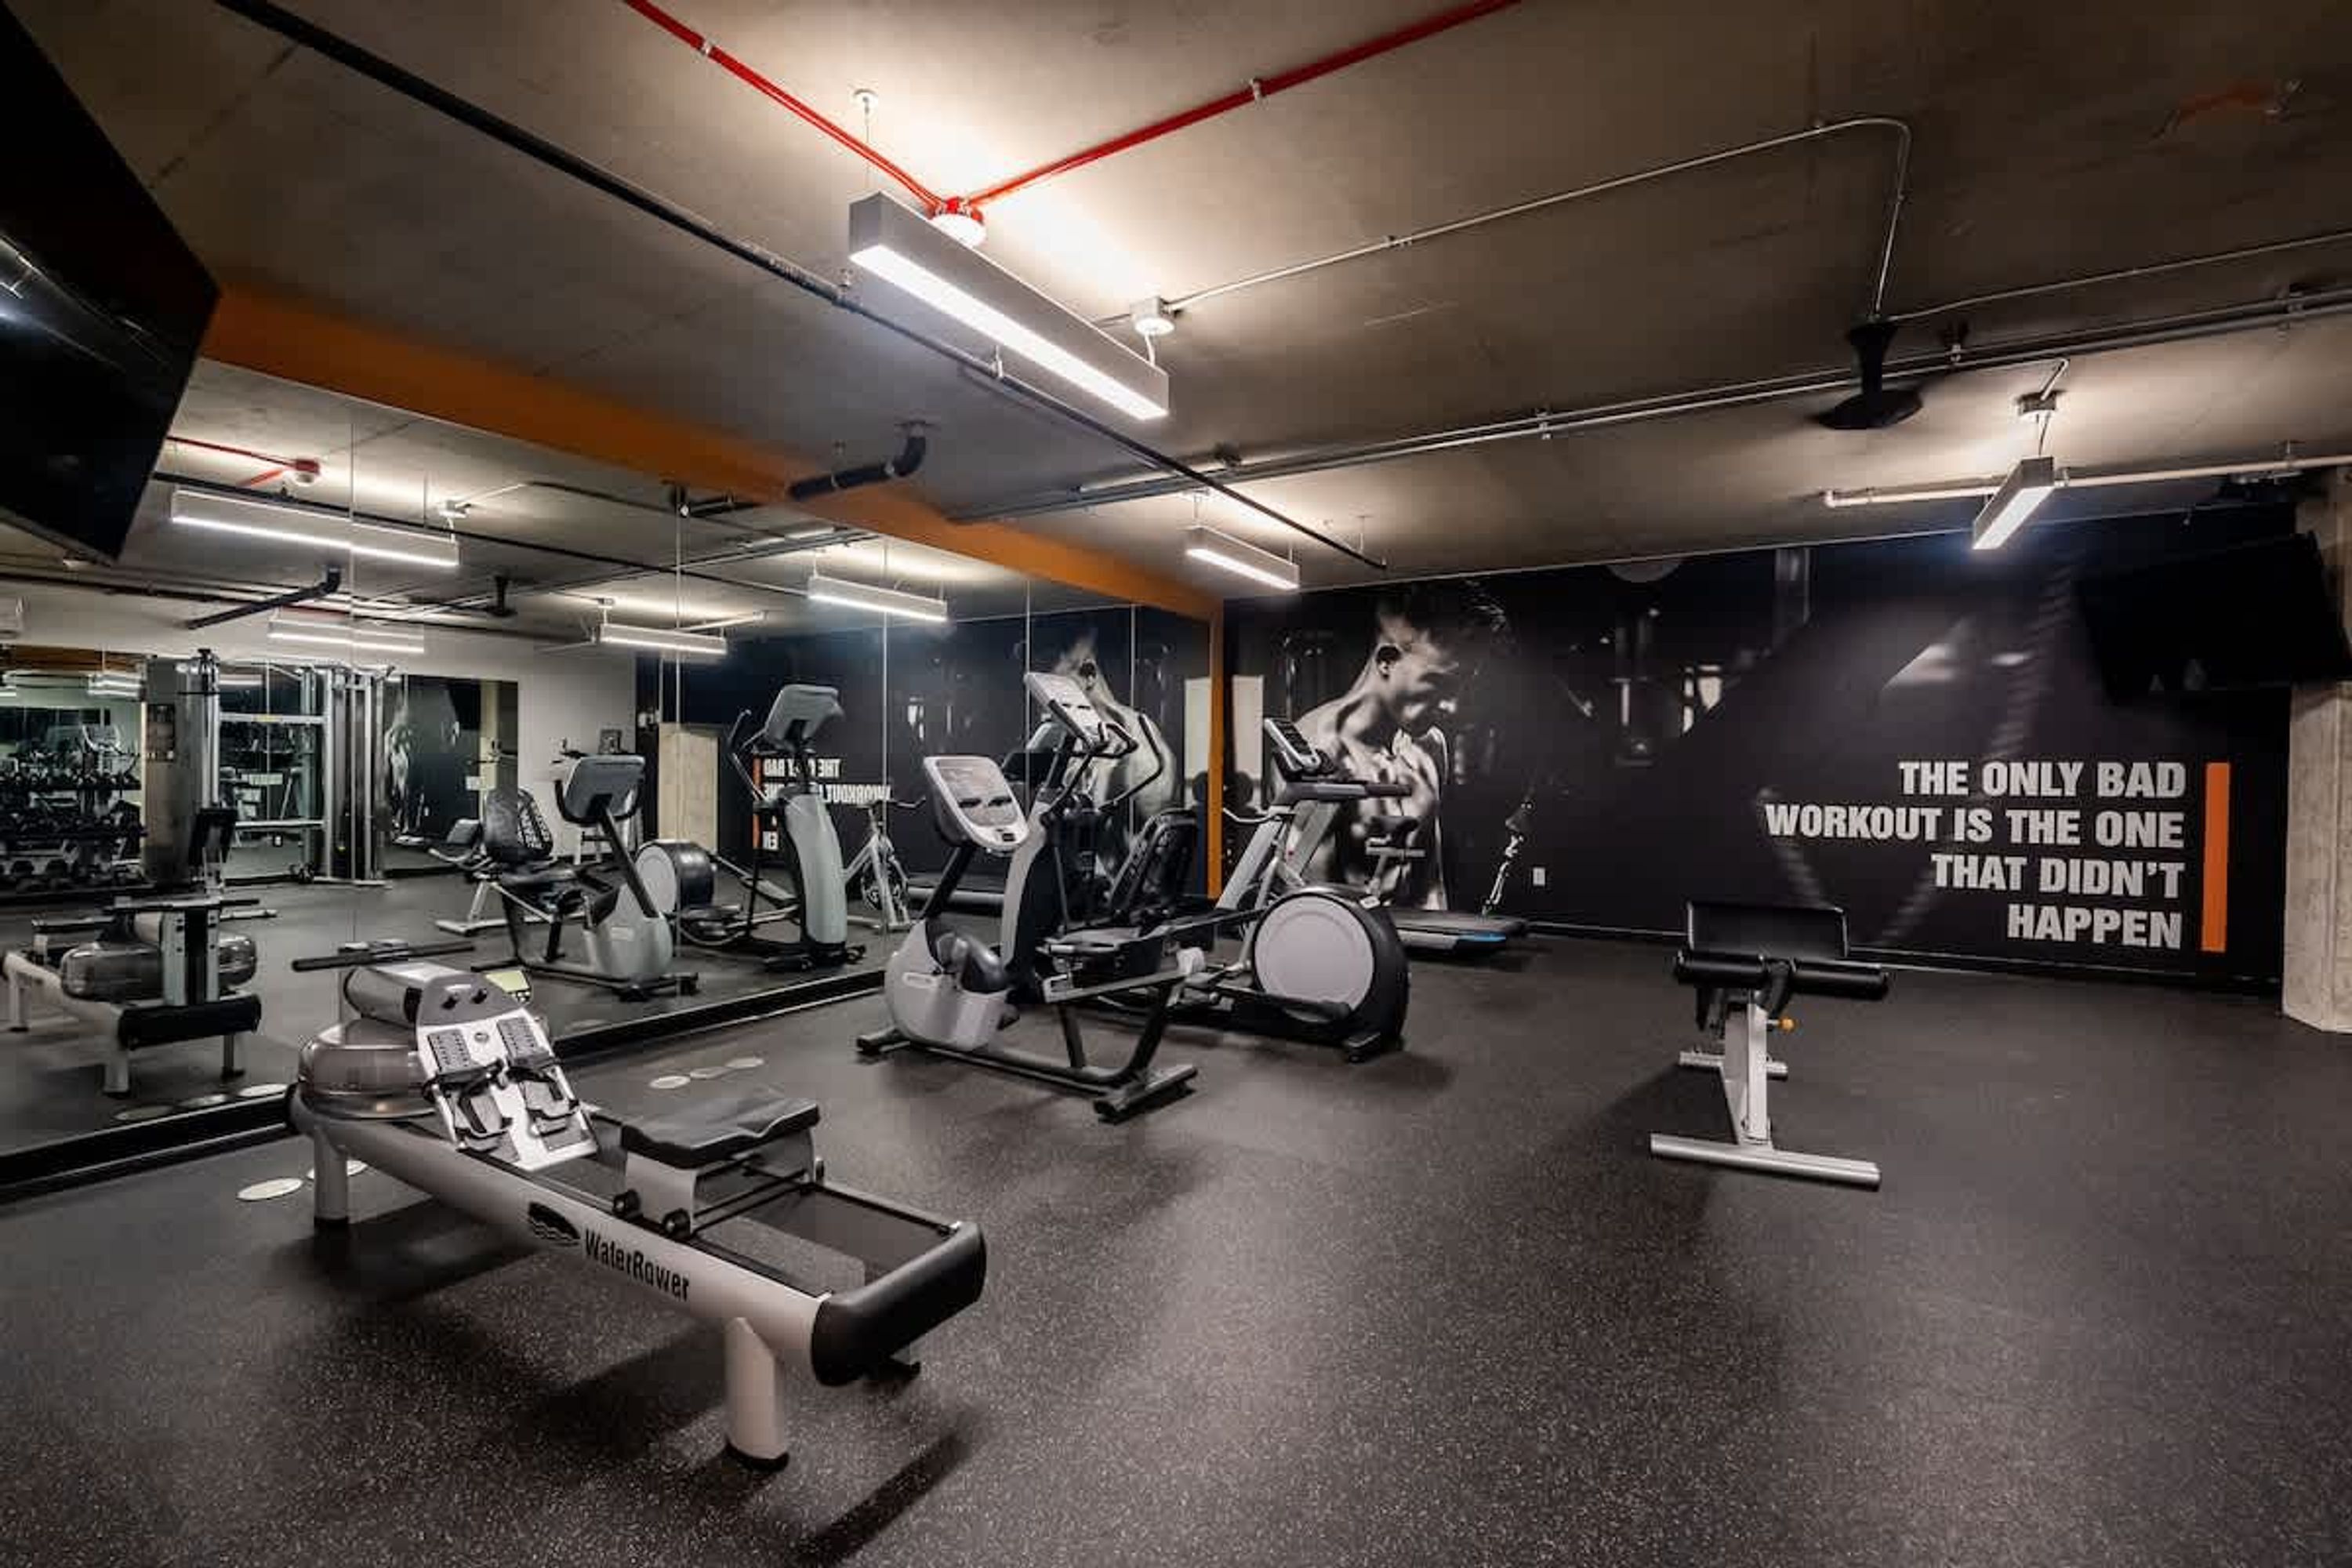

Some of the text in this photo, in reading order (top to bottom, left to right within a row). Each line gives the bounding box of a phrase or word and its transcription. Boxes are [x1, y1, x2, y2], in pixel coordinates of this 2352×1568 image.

[1899, 761, 2186, 798] THE ONLY BAD
[1764, 804, 2185, 848] WORKOUT IS THE ONE
[1930, 854, 2185, 898] THAT DIDN'T
[2007, 905, 2182, 949] HAPPEN
[586, 1229, 689, 1301] WaterRower
